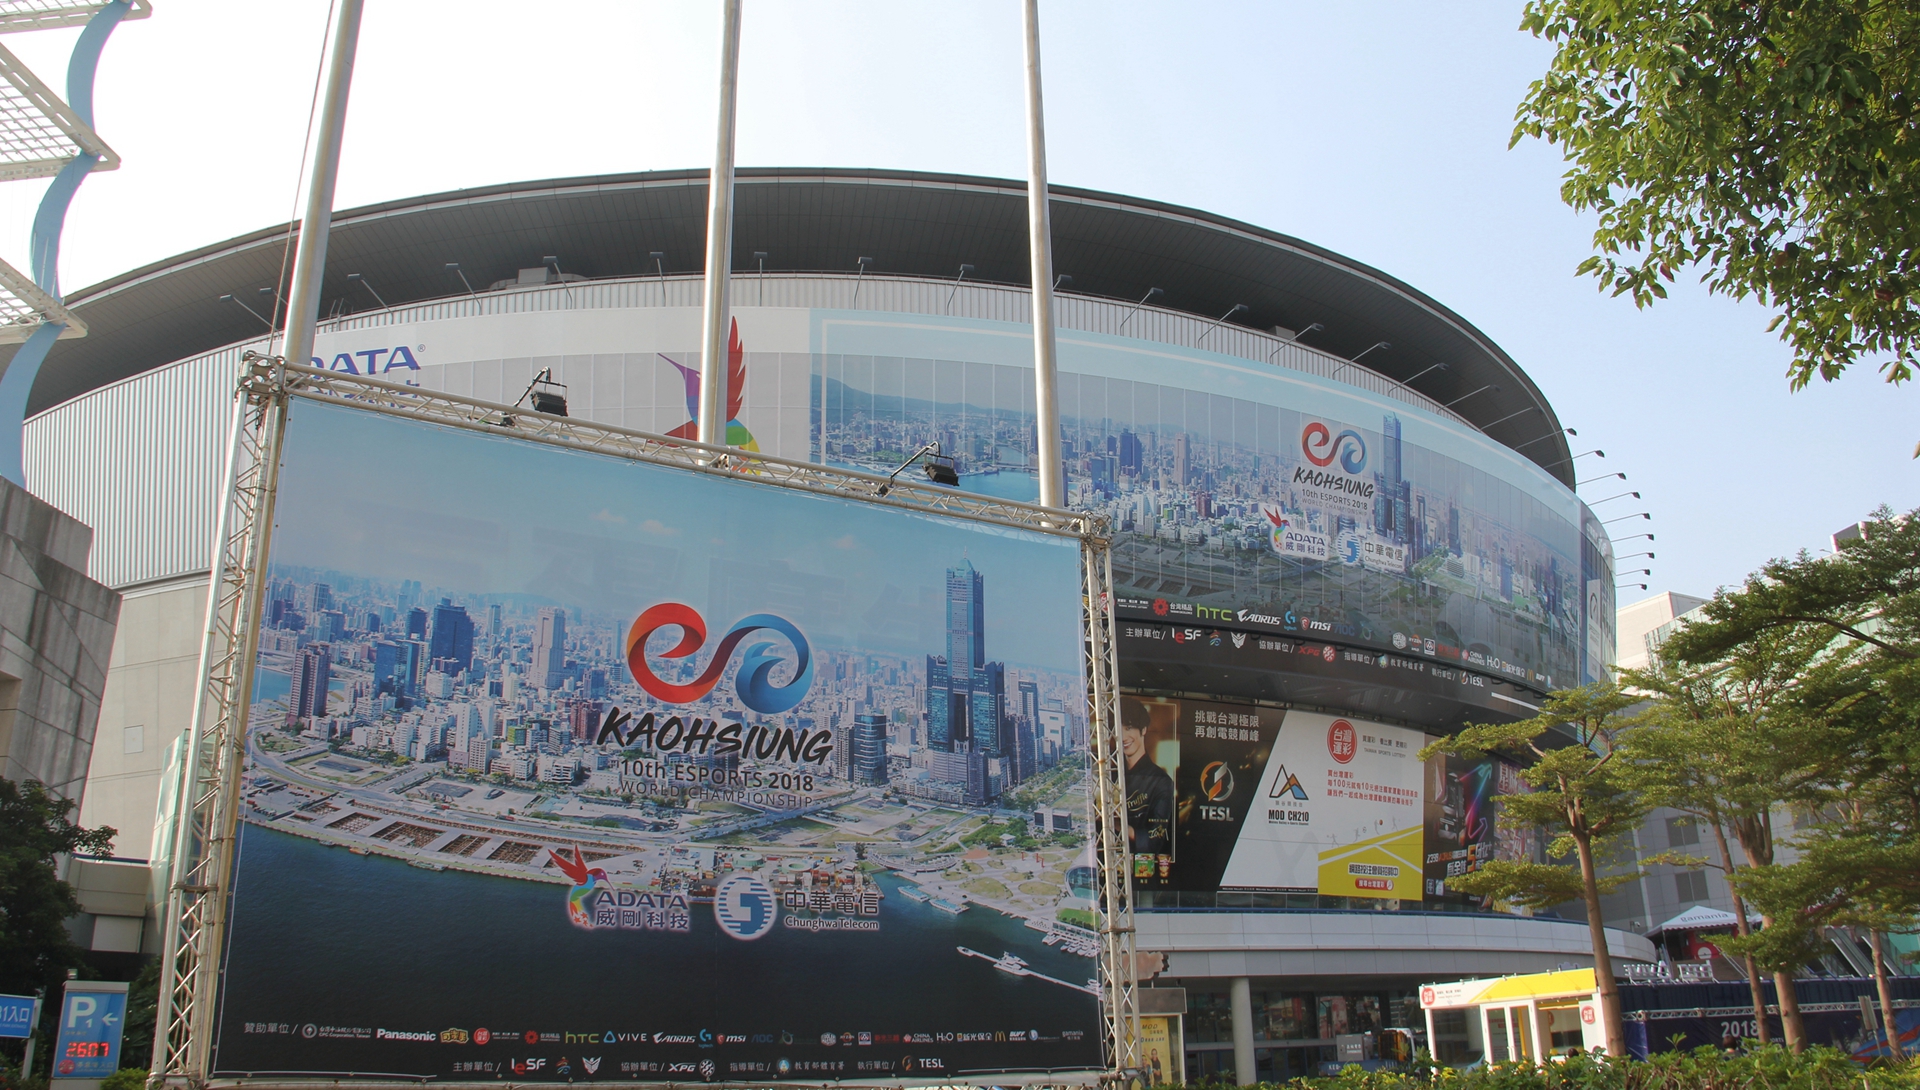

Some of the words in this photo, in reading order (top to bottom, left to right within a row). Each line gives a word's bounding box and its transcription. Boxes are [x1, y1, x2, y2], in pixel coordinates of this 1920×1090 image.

[1293, 466, 1374, 499] KAOHSIUNG
[1302, 488, 1318, 499] 10th
[1321, 492, 1350, 506] ESPORTS
[1352, 499, 1368, 510] 2018
[1285, 532, 1325, 546] ADATA
[1285, 542, 1325, 557] 威剛科技
[1365, 542, 1403, 561] 中華電信
[1248, 613, 1281, 626] AORUS
[1310, 621, 1332, 633] msi
[1298, 646, 1320, 657] XPG
[1470, 651, 1482, 660] CHINA
[1469, 674, 1484, 688] TESL
[1195, 709, 1260, 728] 挑戰台灣極限
[597, 706, 834, 766] KAOHSIUNG
[1195, 725, 1260, 743] 再創電競巔峰
[1333, 727, 1352, 743] 台灣
[1333, 741, 1352, 756] 運彩
[1378, 749, 1391, 757] SPORTS
[621, 759, 667, 780] 10th
[674, 763, 763, 789] ESPORTS
[768, 771, 815, 792] 2018
[621, 779, 681, 798] WORLD
[688, 785, 814, 809] CHAMPIONSHIP
[1199, 805, 1234, 822] TESL
[1268, 809, 1285, 820] MOD
[1288, 810, 1310, 822] CH210
[596, 890, 689, 911] ADATA
[785, 889, 879, 915] 中華電信
[595, 910, 689, 931] 威剛科技
[1680, 912, 1729, 923] gamania
[377, 1028, 436, 1042] Panasonic
[1062, 1030, 1084, 1038] gamania
[1720, 1020, 1759, 1038] 2018
[618, 1033, 647, 1042] VIVE
[661, 1034, 697, 1043] AORUS
[726, 1033, 747, 1043] msi
[65, 1041, 110, 1058] 2607
[668, 1062, 698, 1073] XPG
[919, 1058, 945, 1069] TESL
